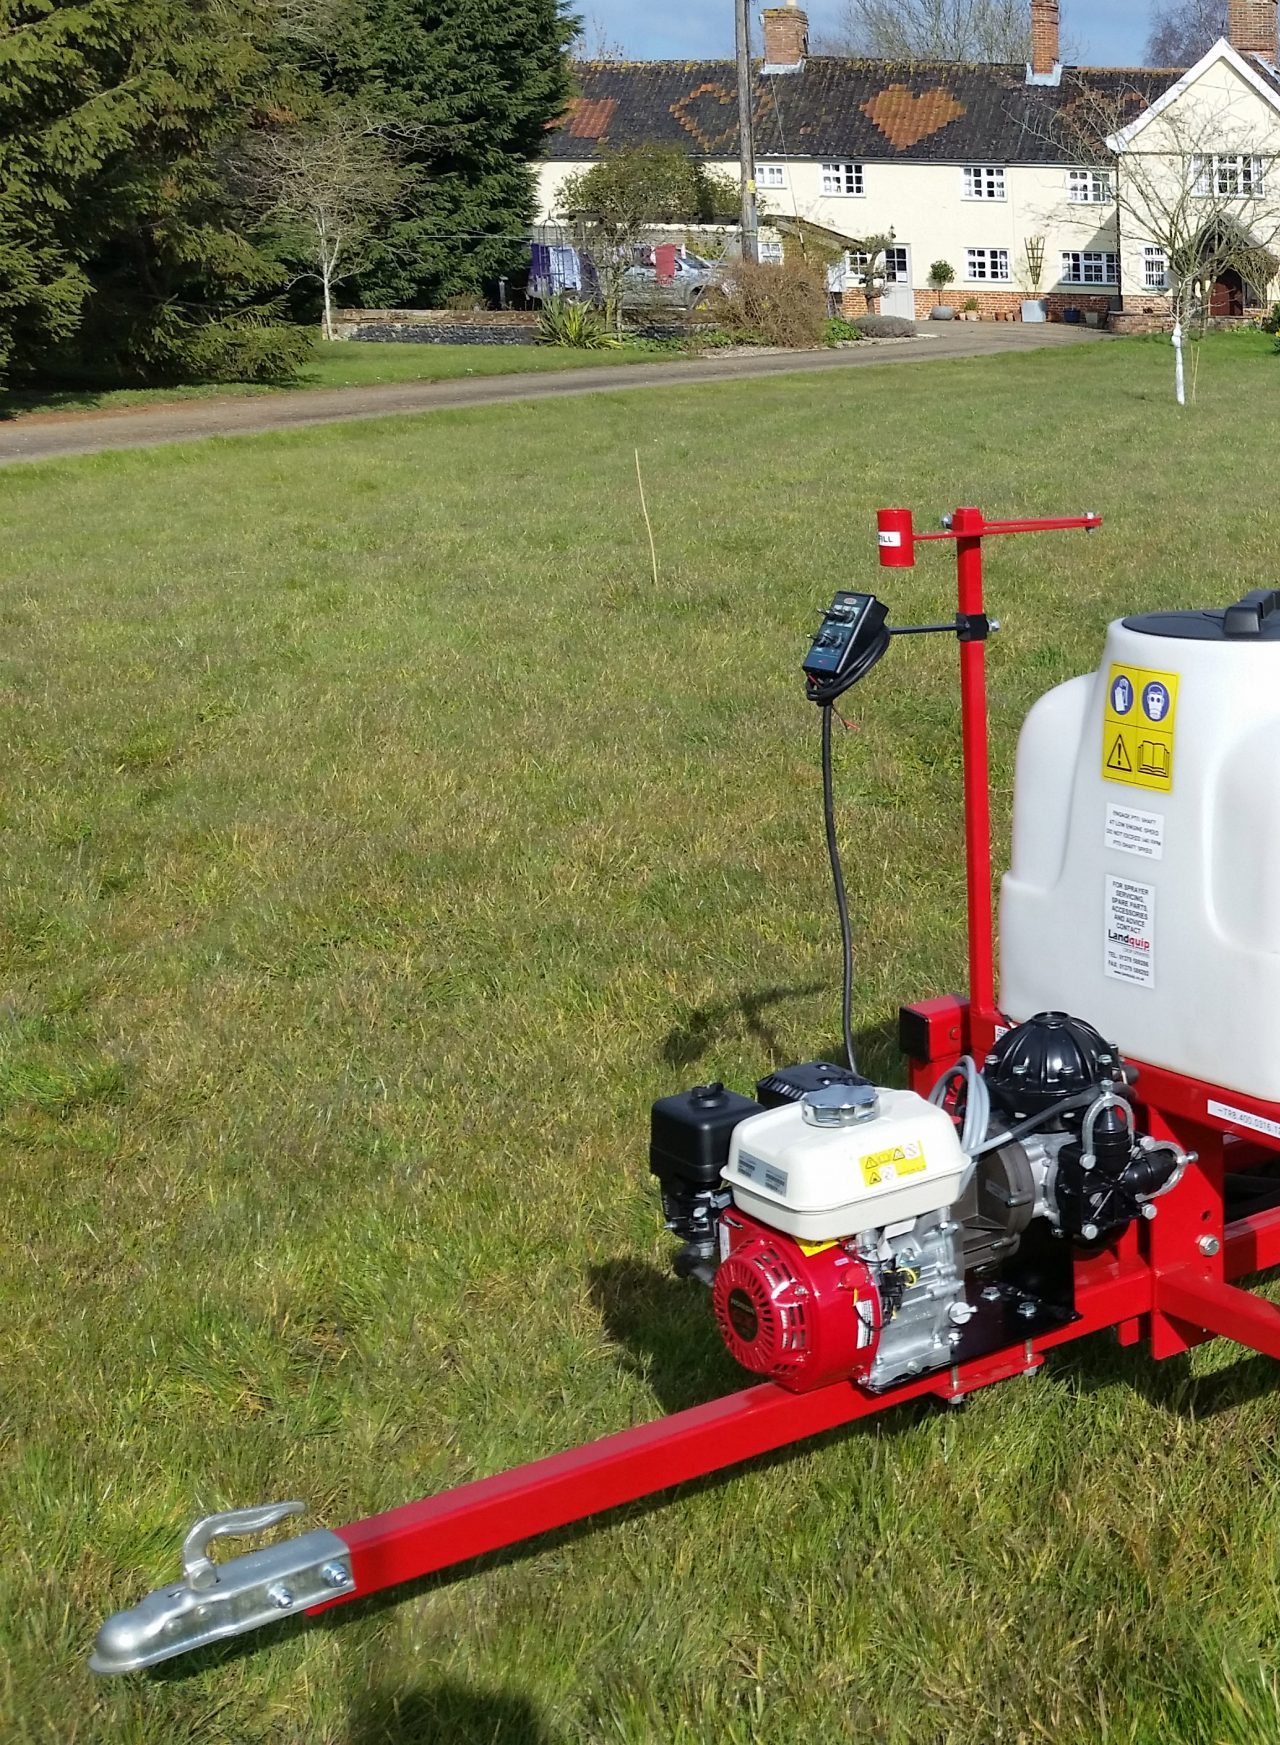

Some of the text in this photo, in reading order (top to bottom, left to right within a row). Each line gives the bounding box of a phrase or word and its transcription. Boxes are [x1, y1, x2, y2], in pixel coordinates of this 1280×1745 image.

[1124, 884, 1149, 895] SPRAYER
[1112, 897, 1128, 907] SPARE
[1112, 905, 1148, 920] ACCESSORIES
[1114, 914, 1145, 928] AND ADVICE
[1116, 922, 1141, 934] CONTACT
[1108, 929, 1150, 951] Landquip
